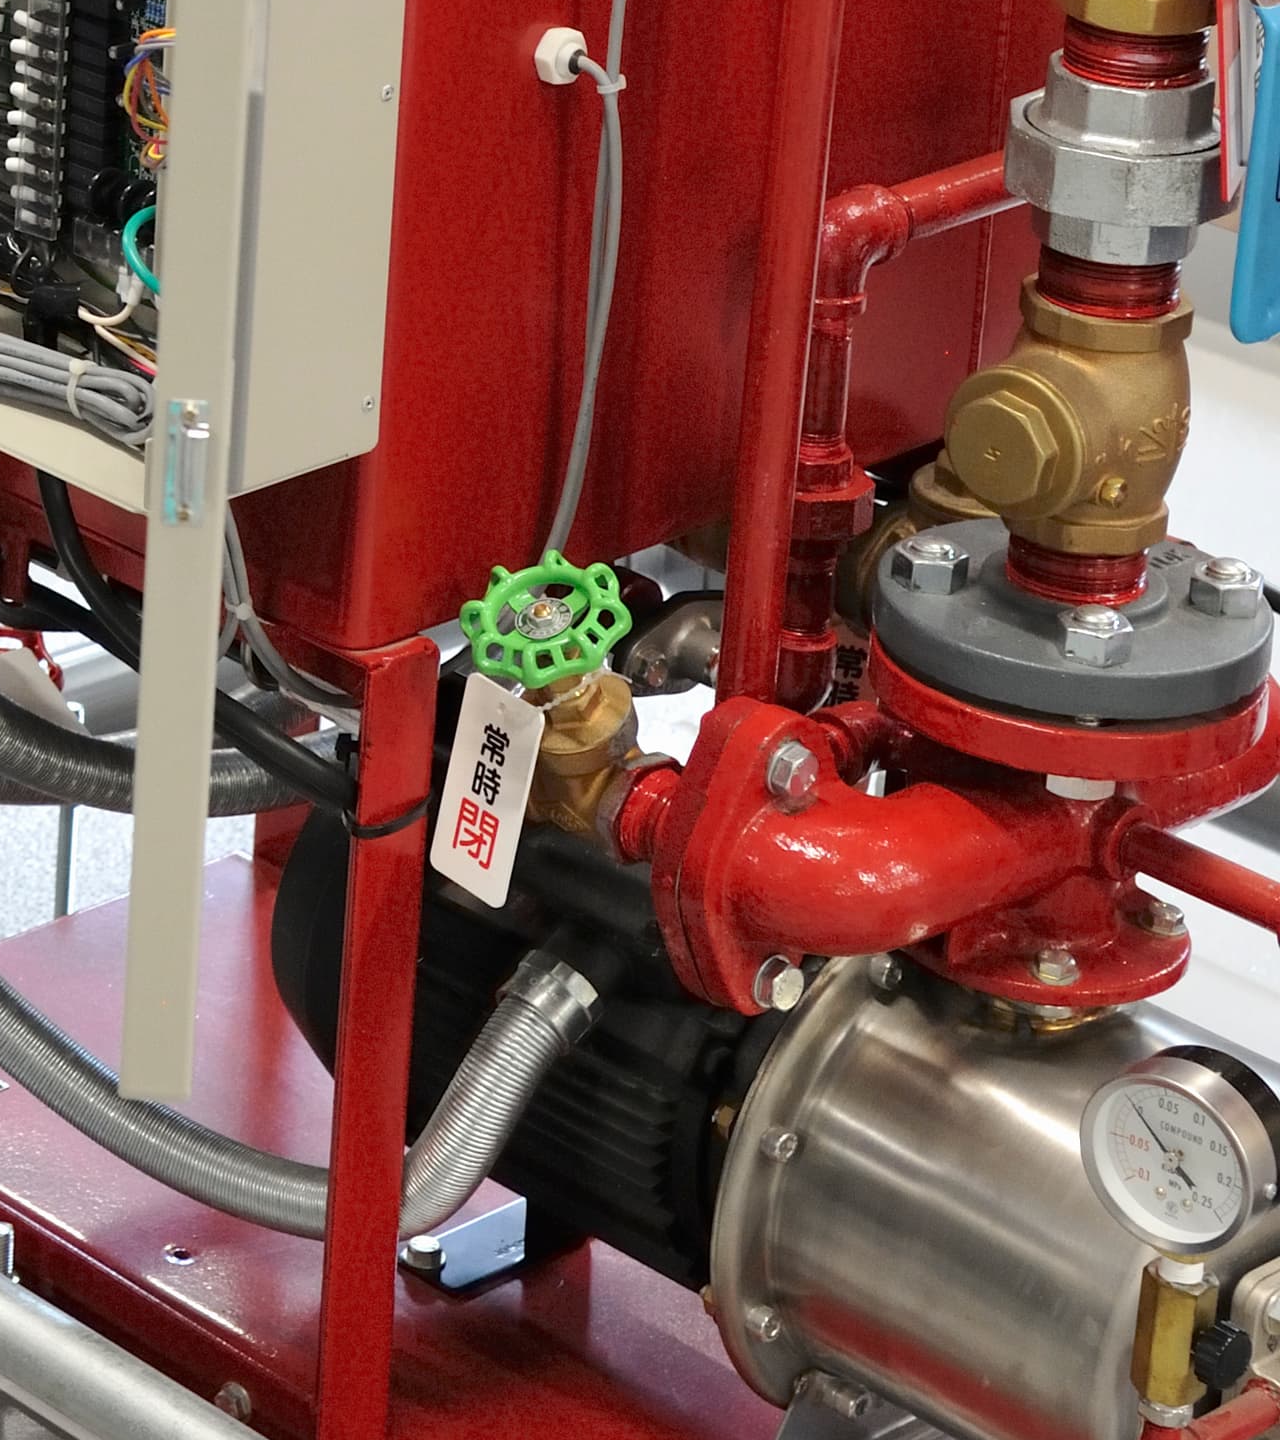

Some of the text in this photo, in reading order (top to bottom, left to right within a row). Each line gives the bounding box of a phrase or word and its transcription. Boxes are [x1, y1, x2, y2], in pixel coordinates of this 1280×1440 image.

[452, 723, 510, 870] 常時閉
[1158, 1098, 1180, 1115] 0.05
[1193, 1111, 1206, 1127] 0.1
[1160, 1120, 1203, 1146] COMPOUND
[1210, 1140, 1228, 1157] 0.15
[1217, 1172, 1232, 1186] 0.2
[1192, 1191, 1213, 1209] 0.25
